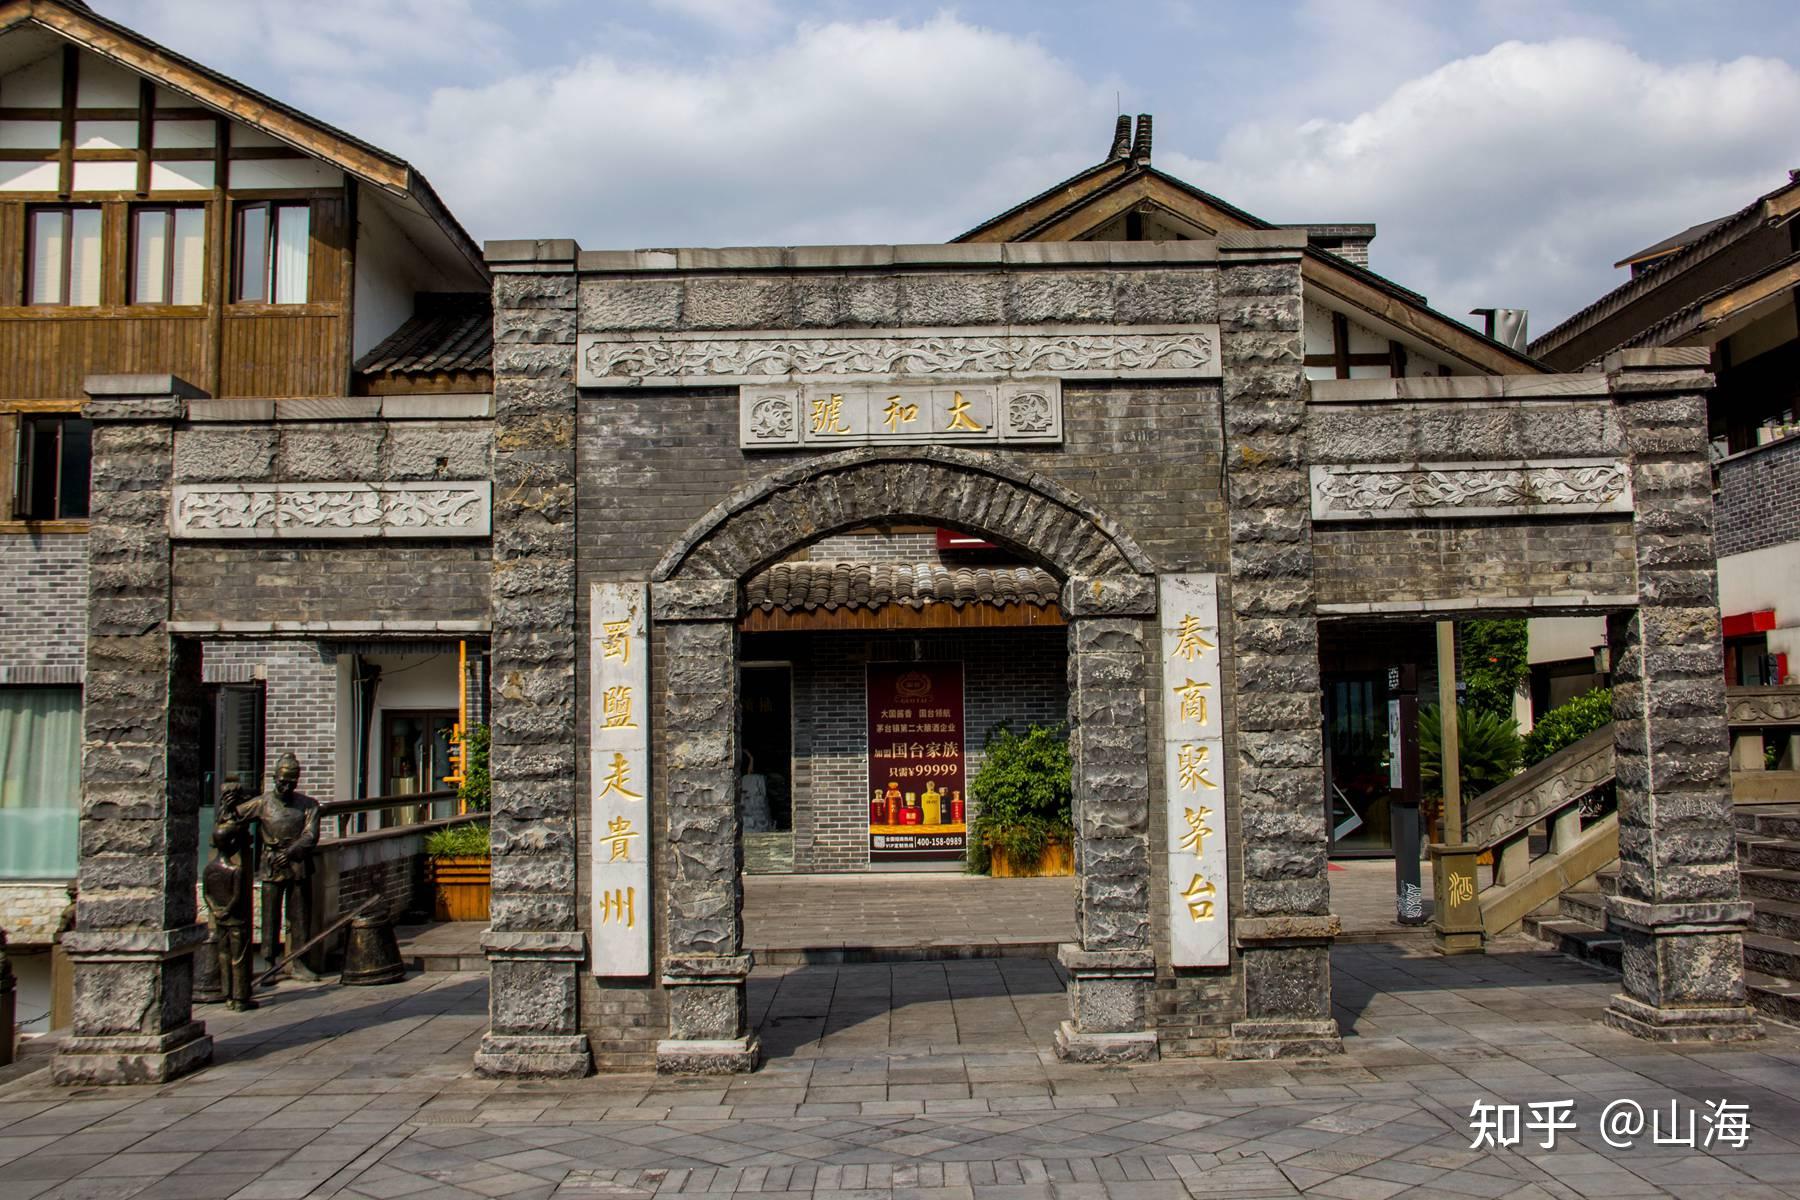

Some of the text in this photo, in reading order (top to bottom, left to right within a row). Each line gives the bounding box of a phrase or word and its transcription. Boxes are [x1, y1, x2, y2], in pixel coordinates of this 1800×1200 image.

[600, 618, 643, 929] 蜀鹽走貴州
[874, 742, 959, 759] 加盟国台家族
[1172, 614, 1217, 923] 秦商聚茅台
[917, 837, 963, 846] 400-158-0989
